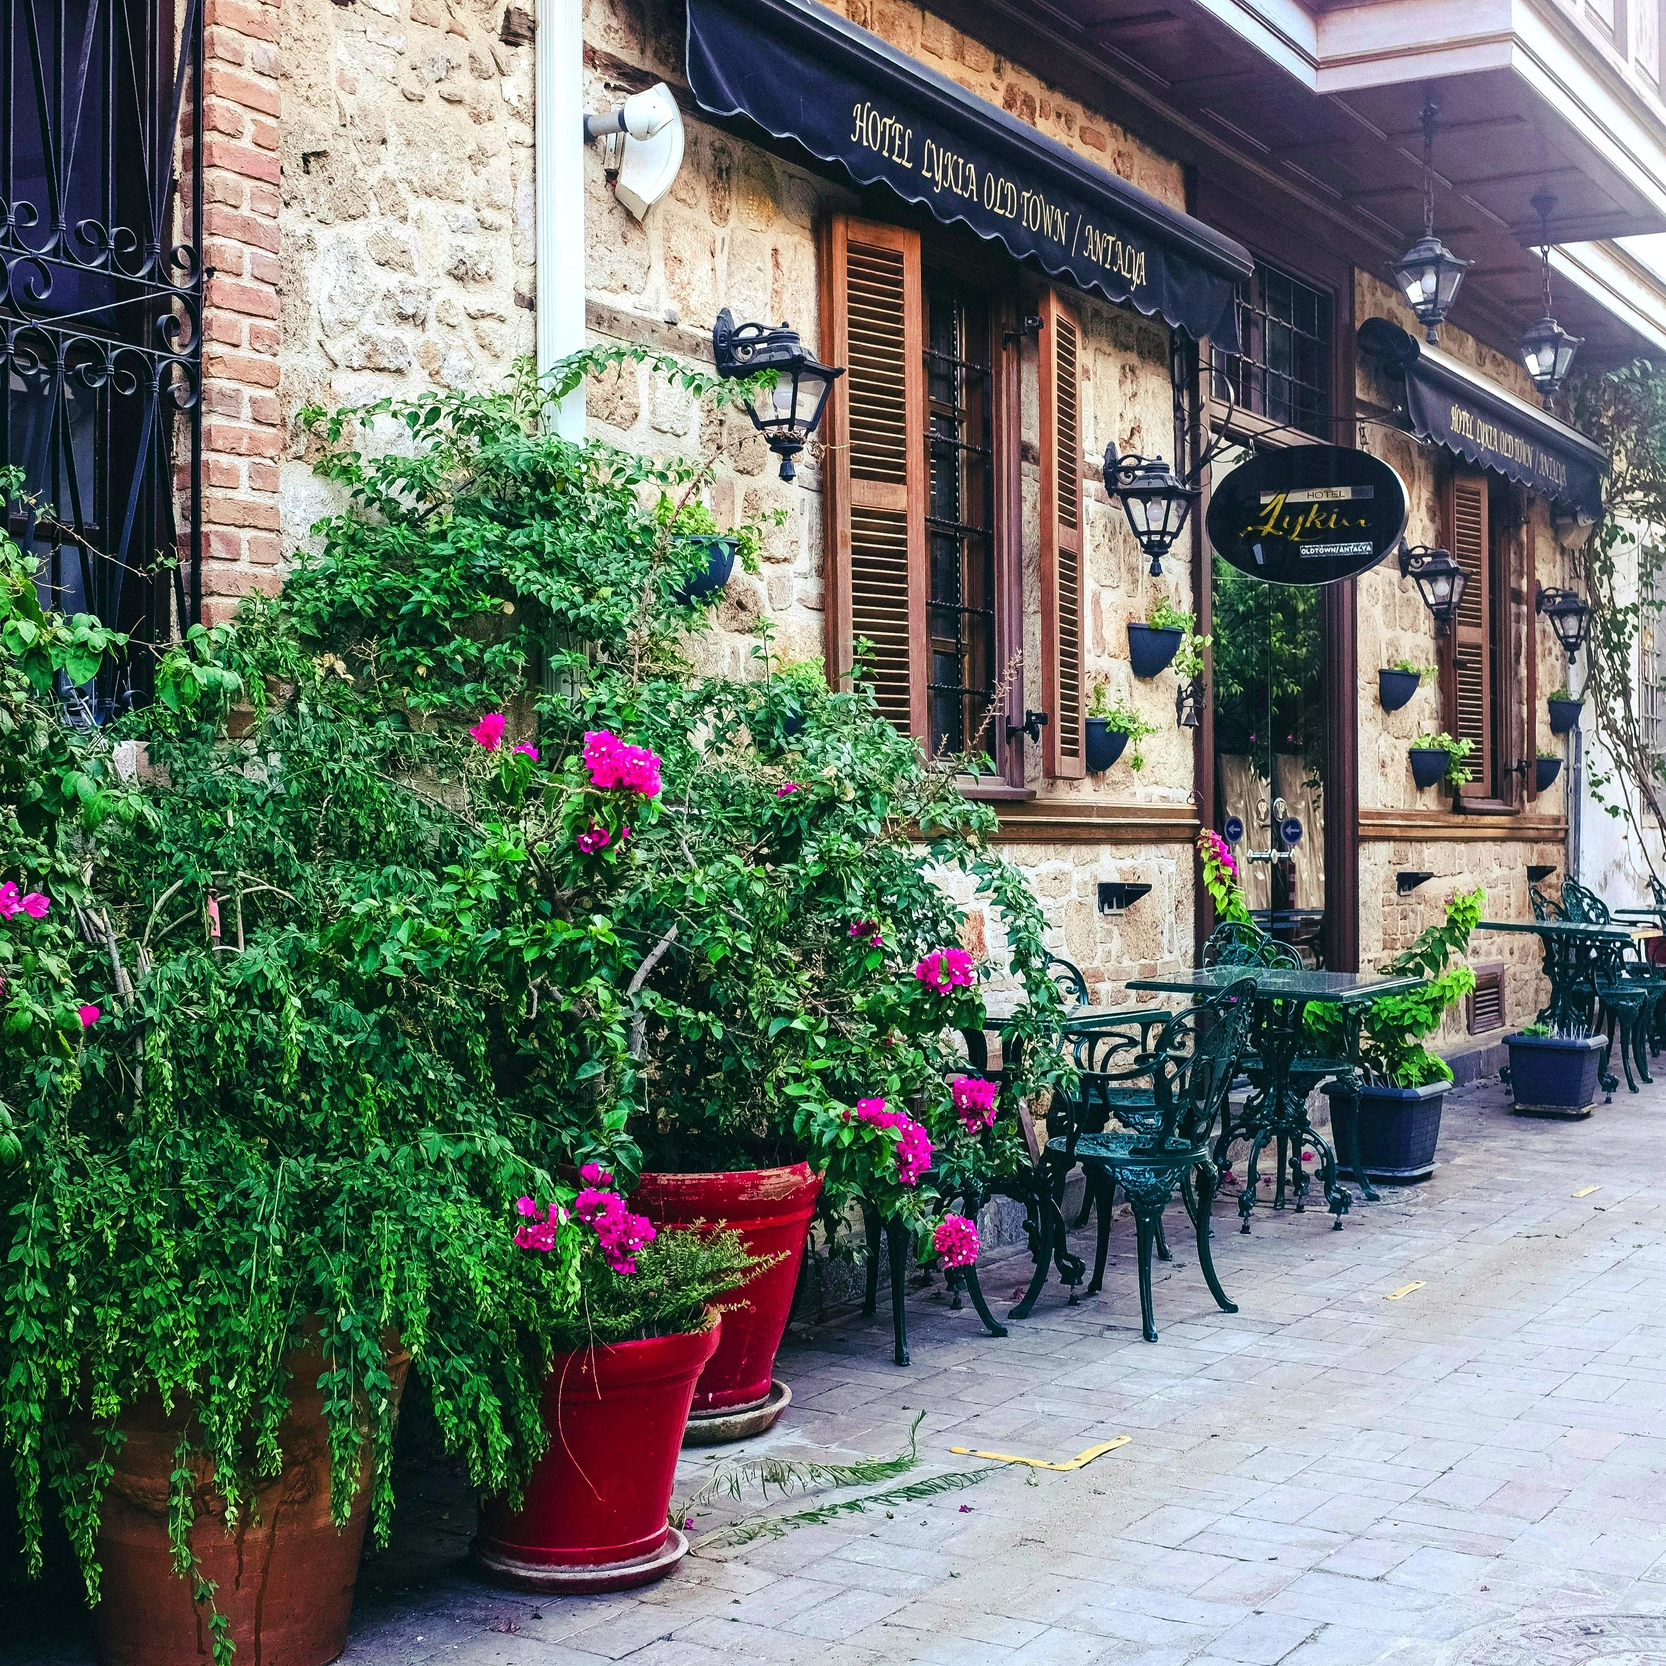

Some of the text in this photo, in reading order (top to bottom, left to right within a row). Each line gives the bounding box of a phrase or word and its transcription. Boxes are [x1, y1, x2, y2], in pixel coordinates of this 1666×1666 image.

[851, 101, 1147, 291] HOTEL LYKIA OLD TOWN / ANTALYA
[1450, 404, 1474, 439] HOTEL
[1500, 431, 1514, 459] OLD
[1306, 490, 1346, 500] HOTEL
[1301, 544, 1372, 555] OLDTOWN/ANTALYA
